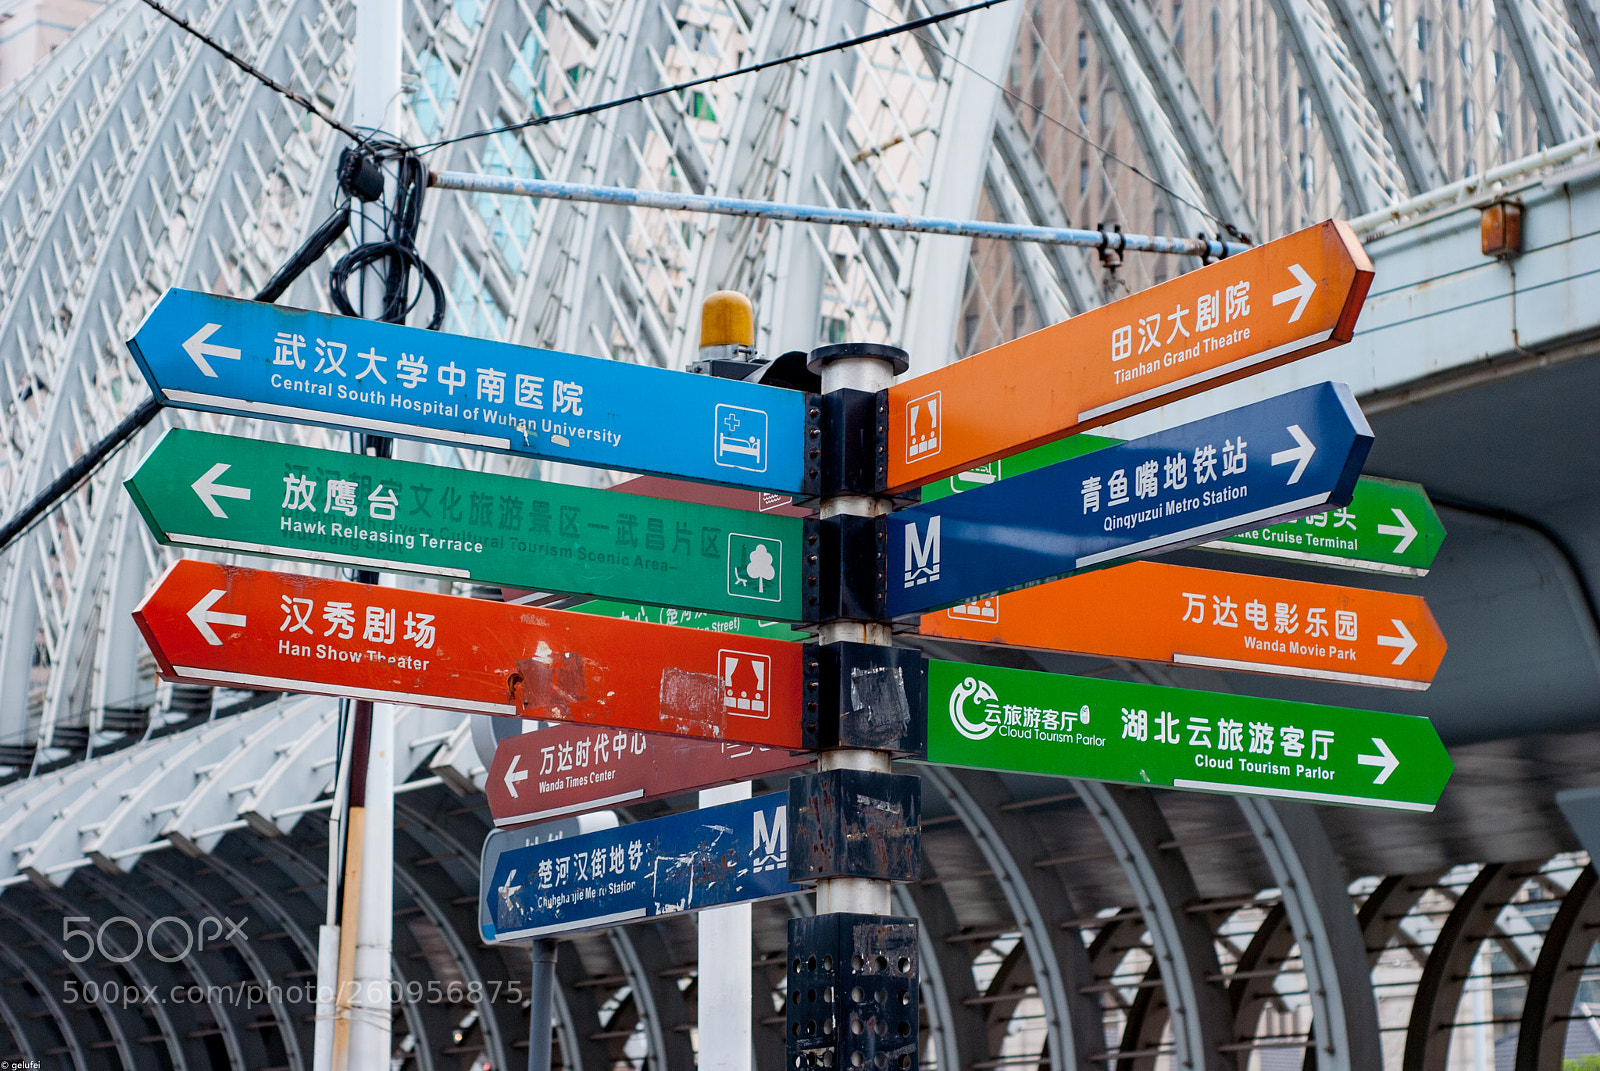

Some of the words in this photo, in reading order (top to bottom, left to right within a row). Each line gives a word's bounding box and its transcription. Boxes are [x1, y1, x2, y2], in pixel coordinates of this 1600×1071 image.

[1111, 280, 1251, 362] 田汉大剧院
[272, 331, 584, 417] 武汉大学中南医院
[1113, 359, 1161, 385] Tianhan
[1163, 342, 1200, 367] Grand
[1202, 327, 1251, 353] Theatre
[270, 373, 333, 397] Central
[337, 384, 386, 406] South
[390, 393, 458, 418] Hospital
[462, 407, 480, 420] of
[482, 408, 537, 431] Wuhan
[541, 418, 622, 447] University
[1080, 435, 1248, 515] 青鱼嘴地铁站
[281, 472, 399, 521] 放鹰台
[1165, 497, 1200, 516] Metro
[1202, 485, 1248, 506] Station
[280, 516, 327, 535] Hawk
[331, 522, 415, 550] Releasing
[419, 533, 483, 553] Terrace
[1261, 528, 1303, 544] Cruise
[1305, 533, 1358, 551] Terminal
[279, 594, 436, 650] 汉秀剧场
[1181, 592, 1358, 642] 万达电影乐园
[278, 639, 312, 657] Han
[315, 643, 363, 663] Show
[366, 649, 430, 671] Theater
[1243, 635, 1286, 653] Wanda
[1289, 641, 1326, 658] Movie
[1328, 646, 1357, 661] Park
[983, 703, 1079, 732] 云旅游客厅
[997, 725, 1032, 739] Cloud
[1034, 728, 1074, 744] Tourism
[1075, 733, 1106, 747] Parlor
[1120, 706, 1336, 761] 湖北云旅游客厅
[539, 730, 647, 776] 万达时代中心
[1194, 753, 1234, 770] Cloud
[1238, 758, 1291, 776] Tourism
[1295, 764, 1336, 781] Parlor
[538, 778, 564, 794] Wanda
[565, 775, 588, 789] Times
[589, 769, 616, 784] Center
[608, 879, 636, 895] Station
